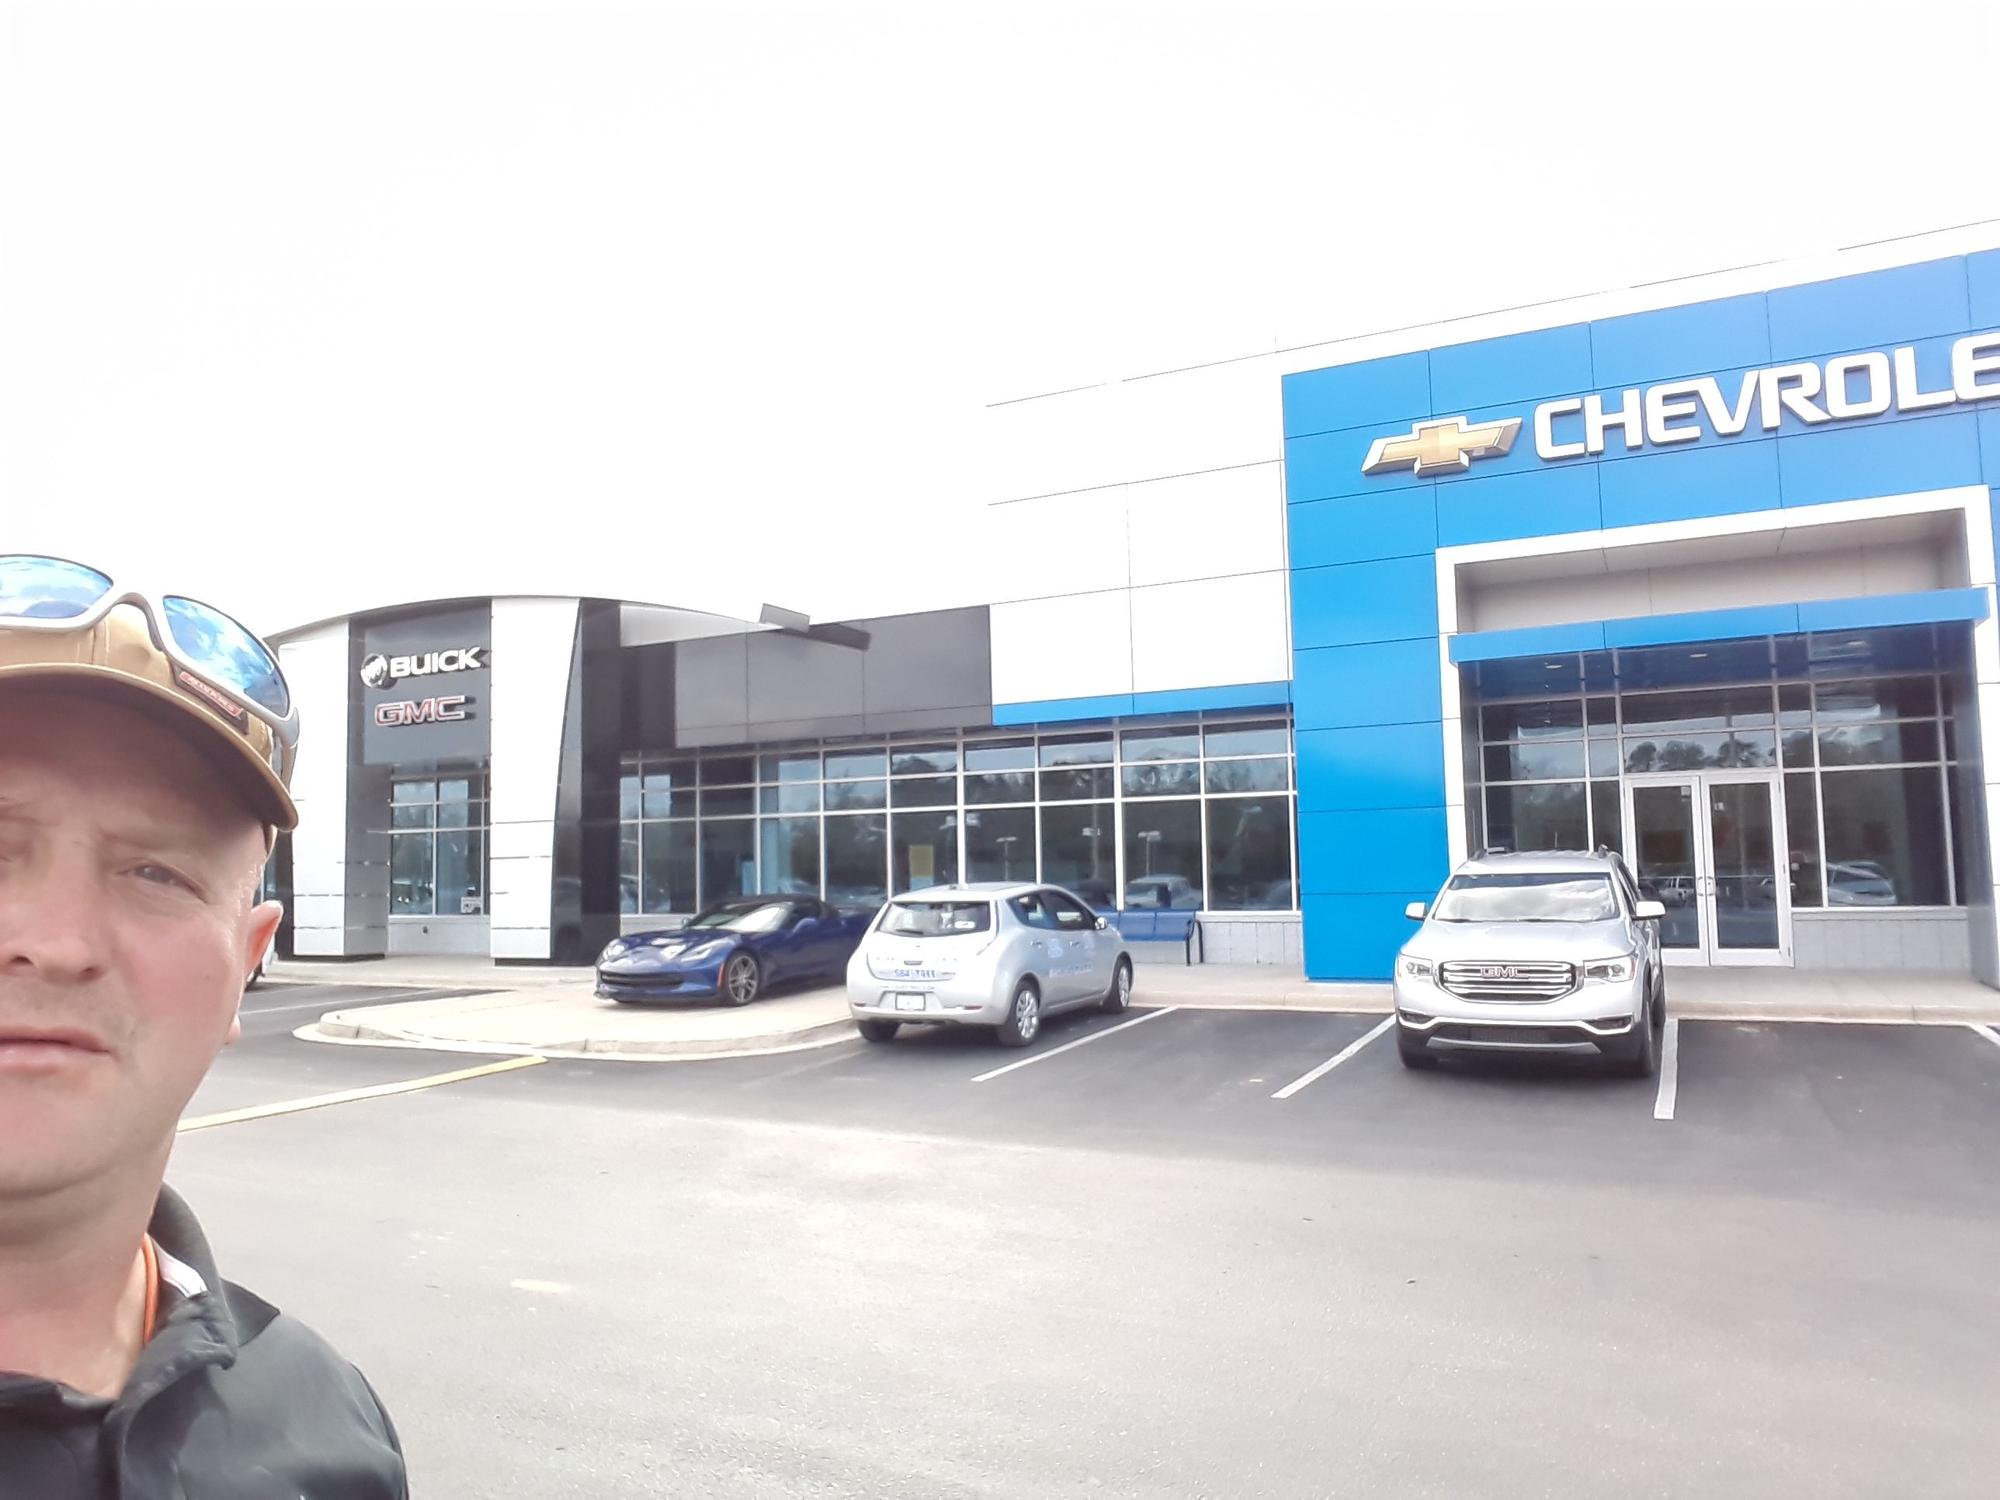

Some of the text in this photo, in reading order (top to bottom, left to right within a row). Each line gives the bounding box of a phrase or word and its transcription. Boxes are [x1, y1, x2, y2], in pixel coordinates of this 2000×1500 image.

[390, 646, 481, 678] BUICK
[375, 695, 466, 726] GMC
[1481, 966, 1529, 979] GMC
